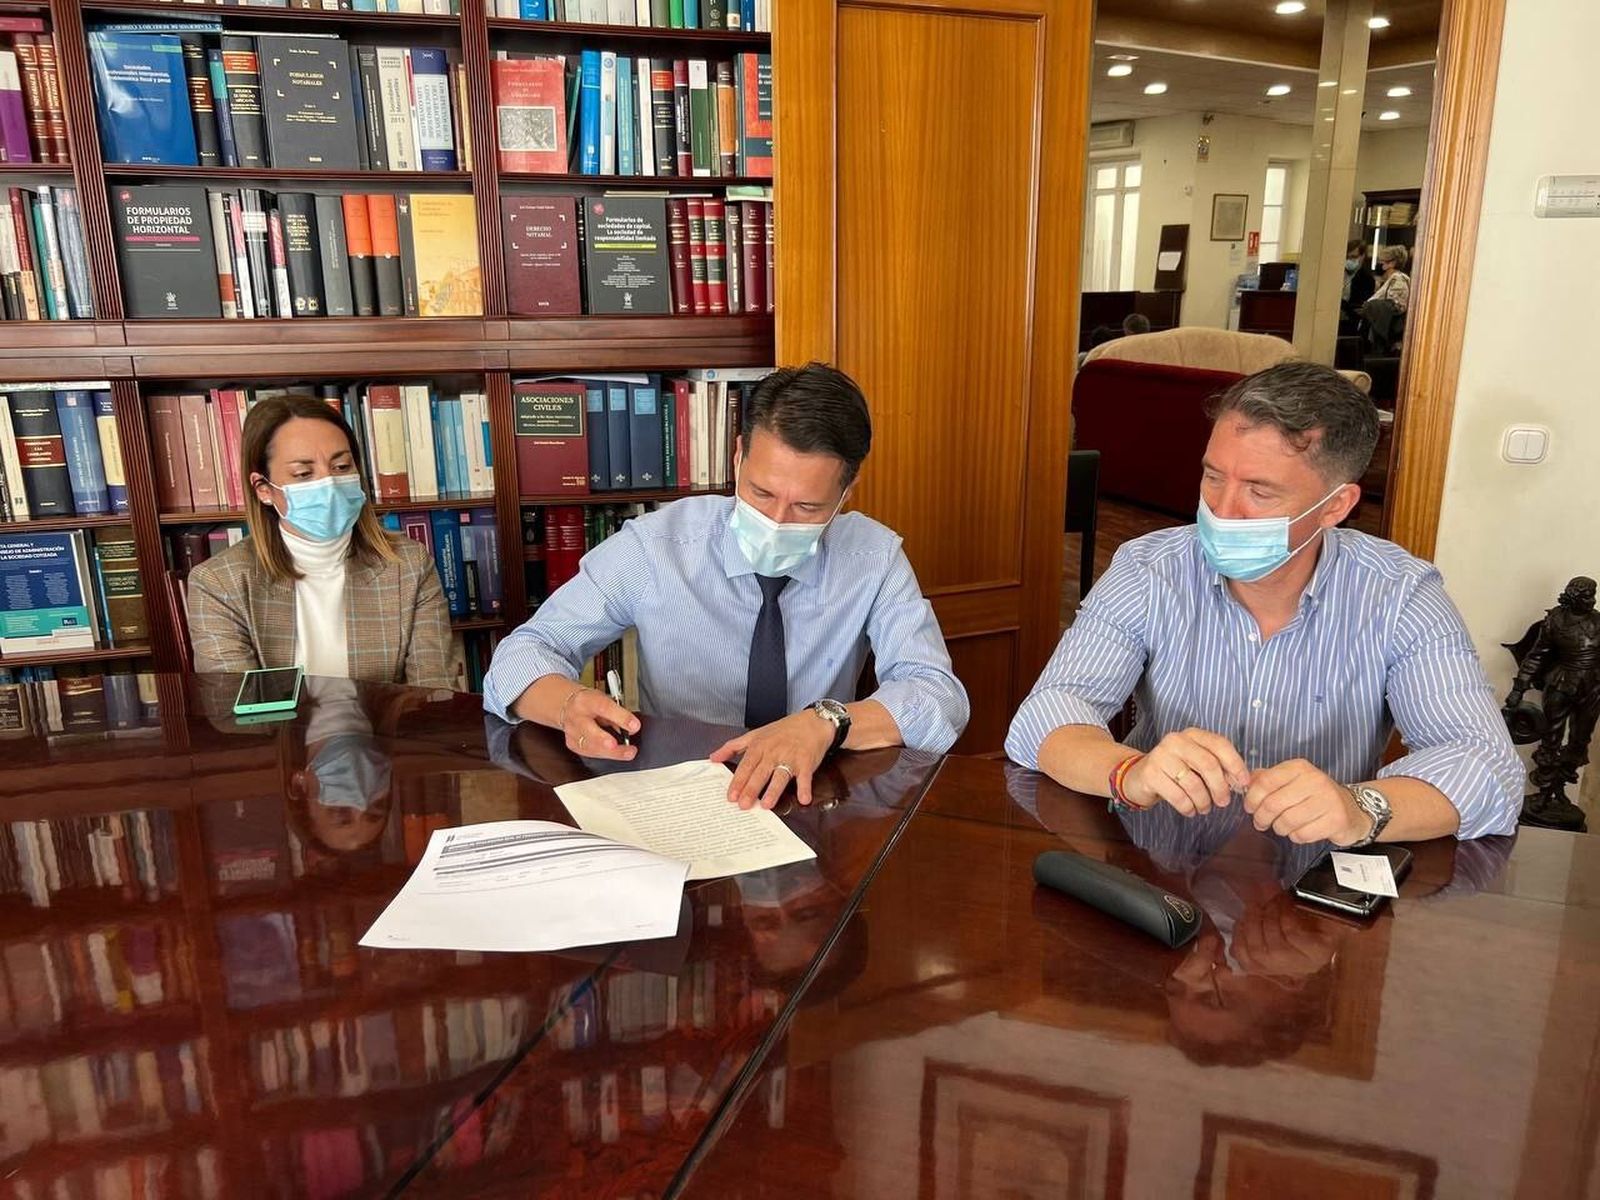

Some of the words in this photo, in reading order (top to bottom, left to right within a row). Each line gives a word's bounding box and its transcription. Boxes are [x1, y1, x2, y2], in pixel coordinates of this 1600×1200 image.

[126, 206, 191, 216] FORMULARIOS
[127, 216, 139, 225] DE
[141, 216, 192, 225] PROPIEDAD
[133, 225, 190, 234] HORIZONTAL
[520, 396, 574, 404] ASOCIACIONES
[22, 546, 65, 554] ADMINISTRACIÓN
